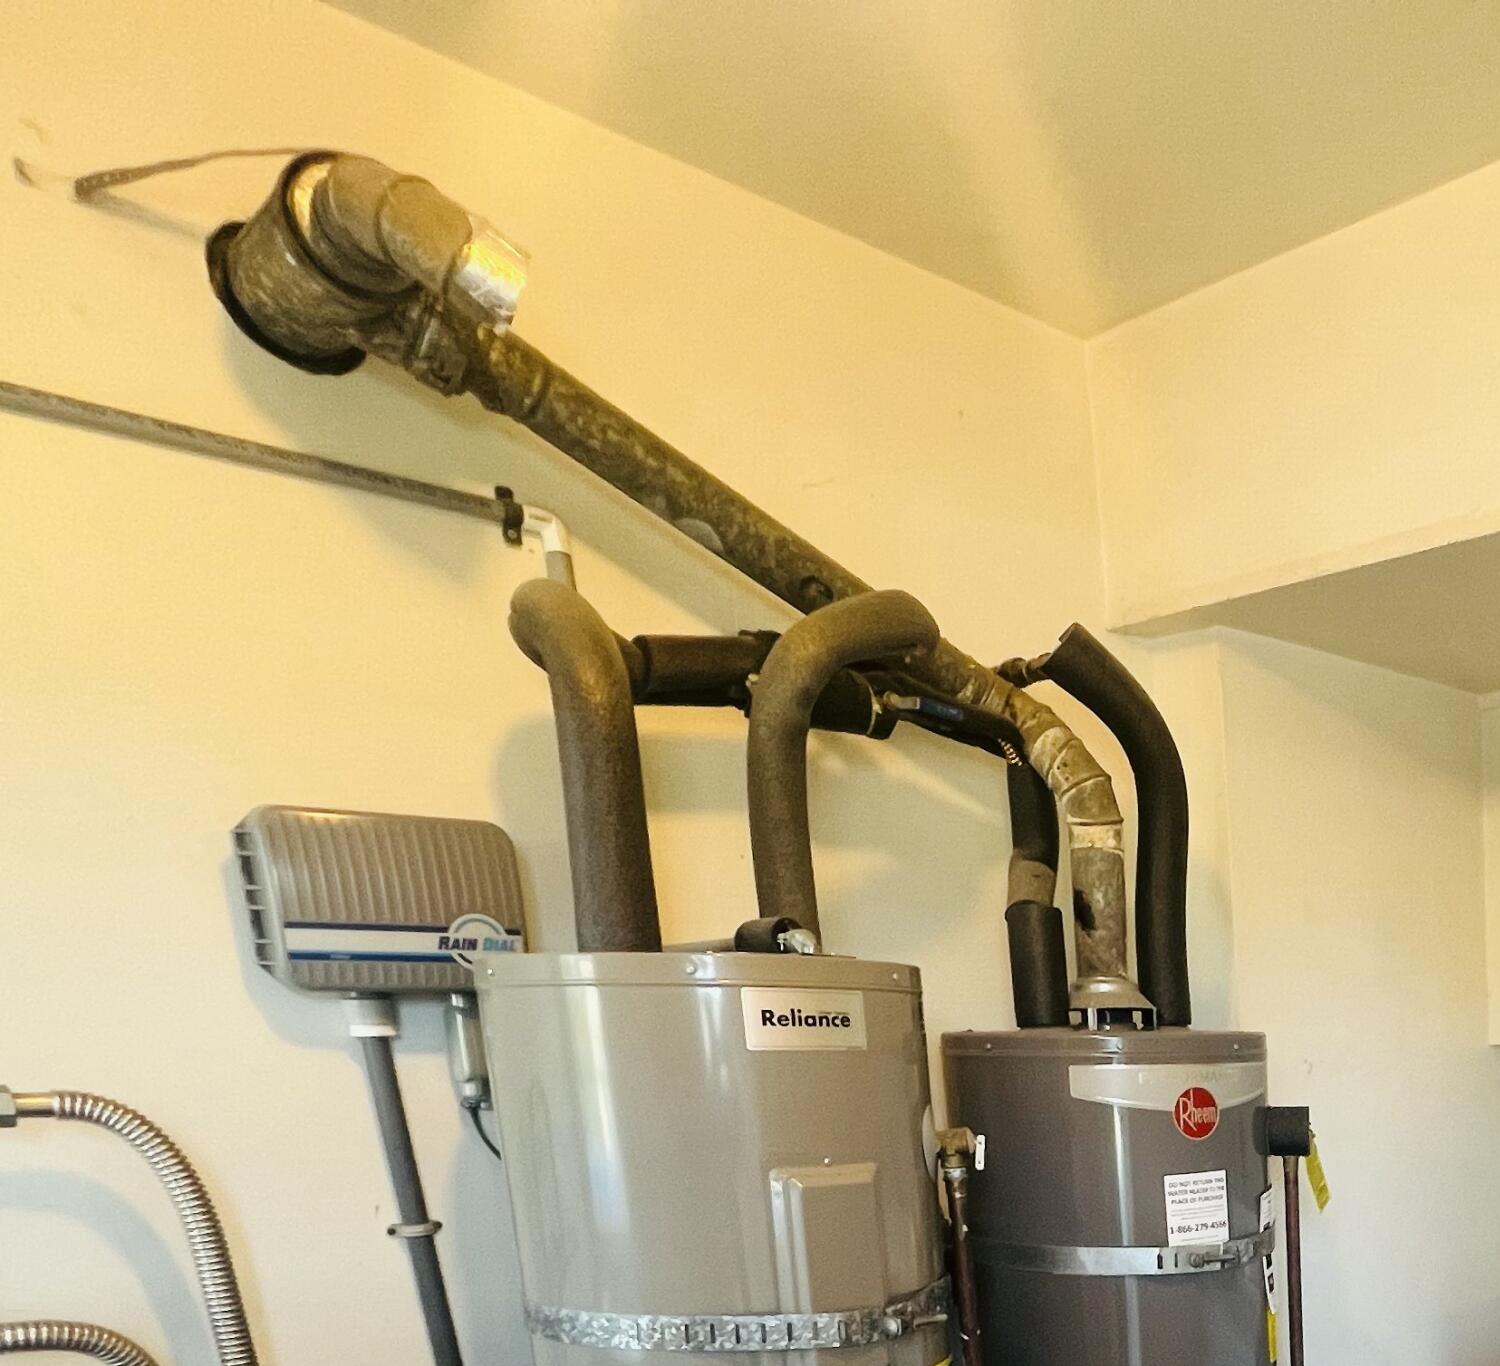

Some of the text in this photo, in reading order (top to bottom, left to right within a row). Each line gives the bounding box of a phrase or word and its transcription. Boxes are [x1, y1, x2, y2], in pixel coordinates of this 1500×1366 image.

[438, 936, 517, 952] RAIN DIAL
[760, 1008, 852, 1029] Reliance
[1179, 1088, 1218, 1132] Rheem
